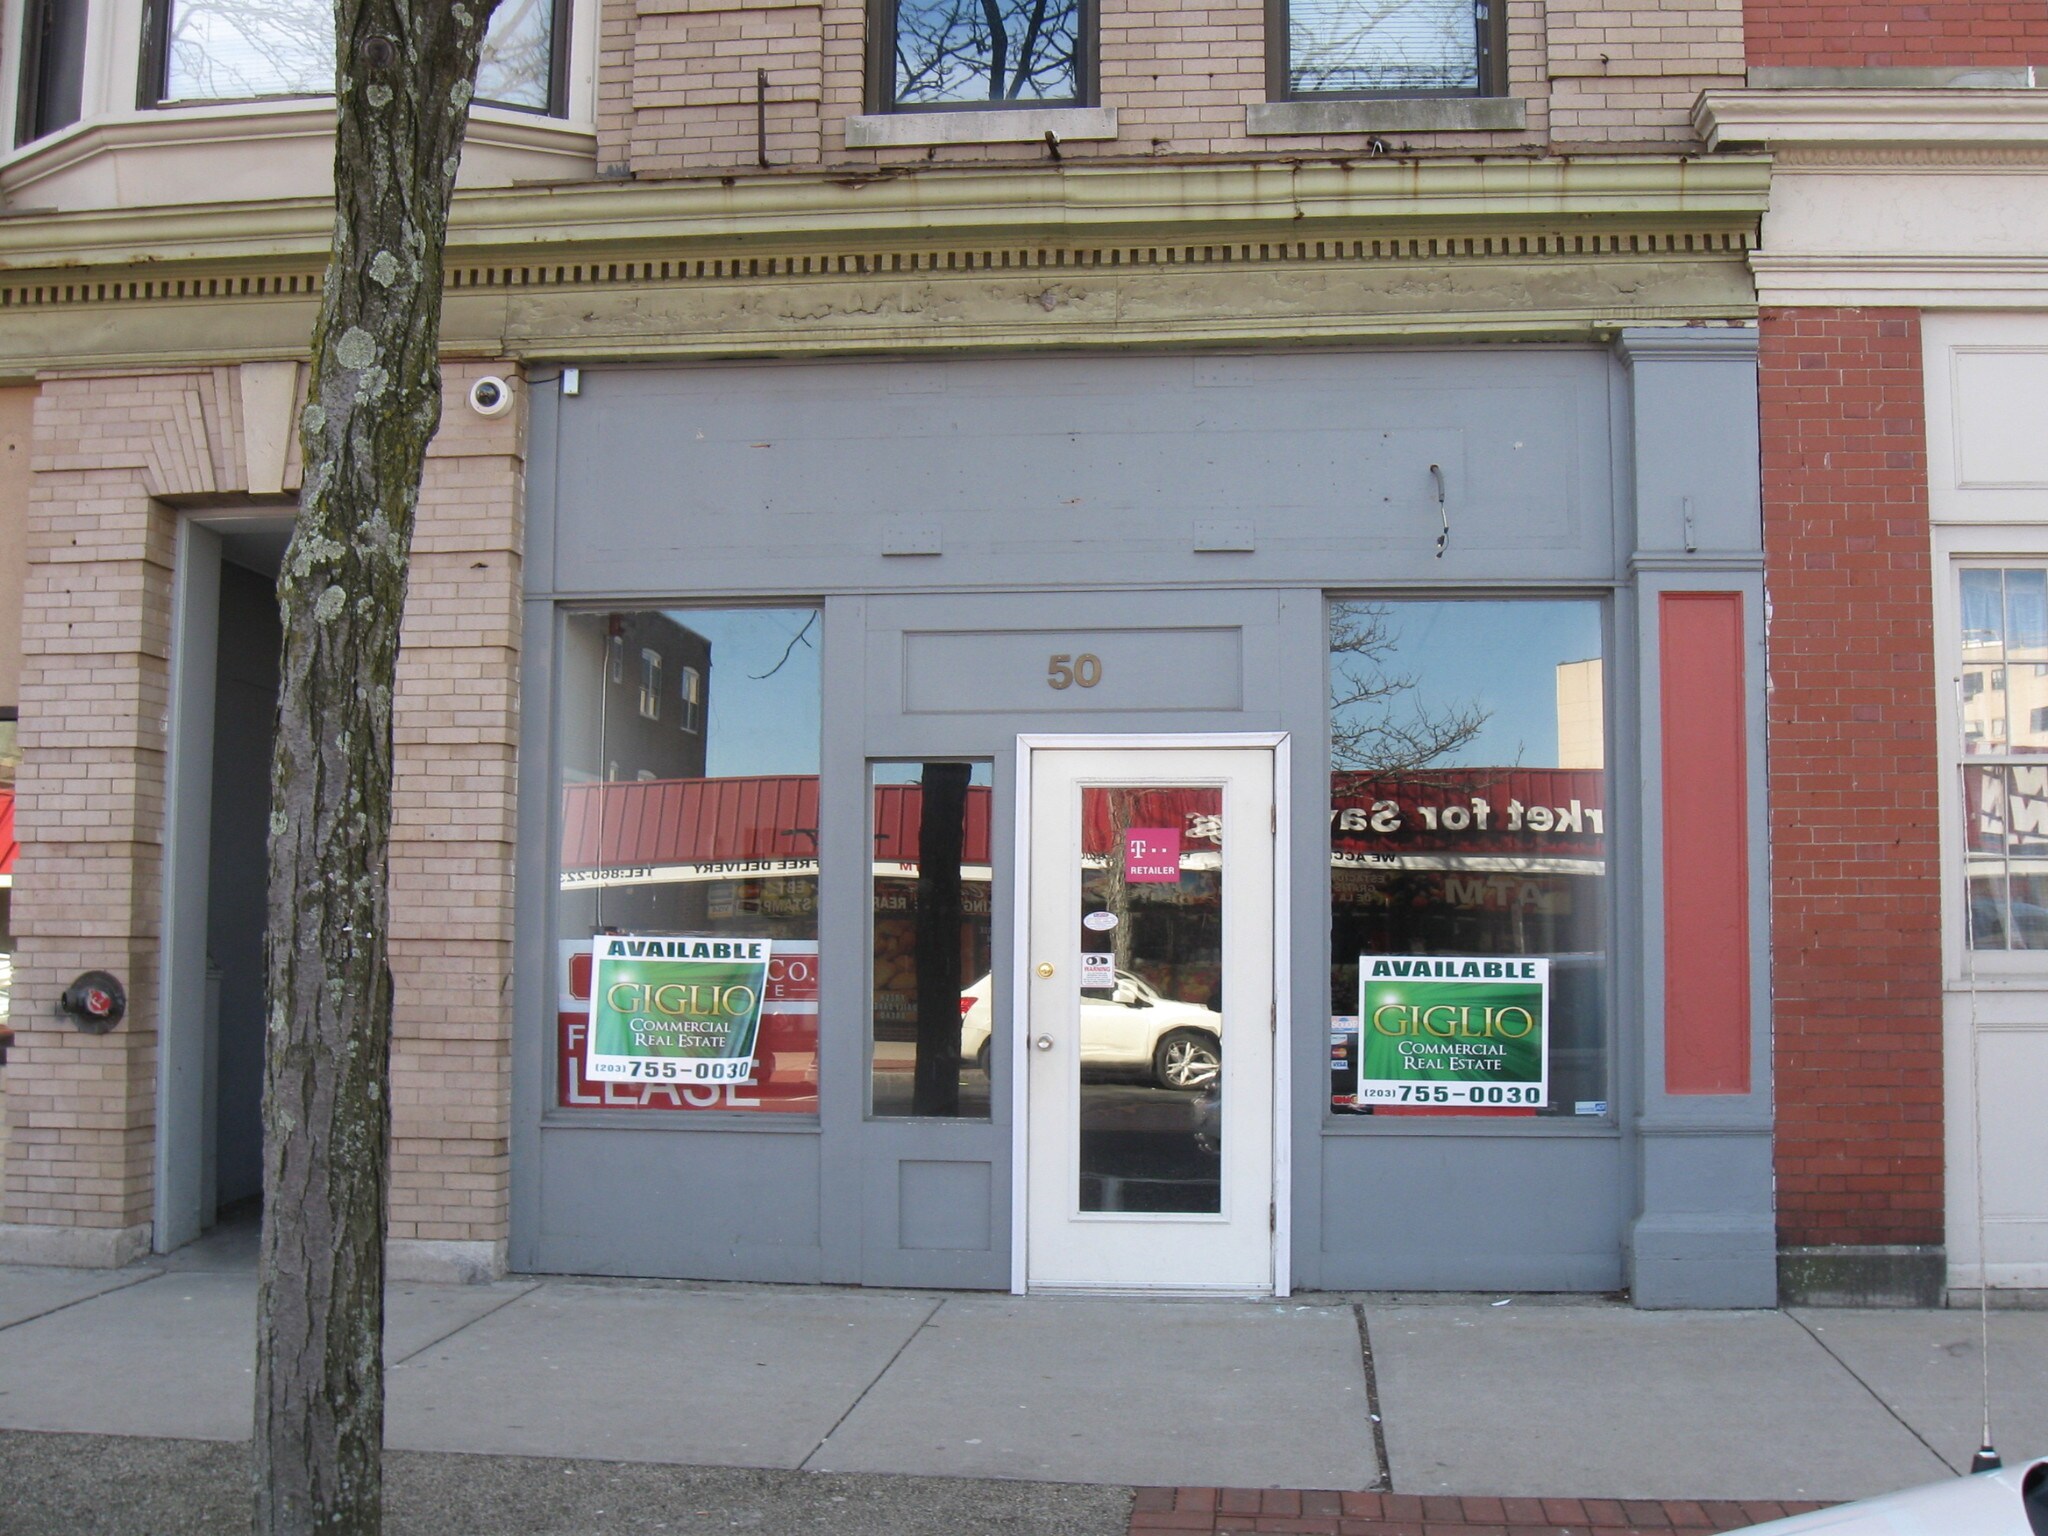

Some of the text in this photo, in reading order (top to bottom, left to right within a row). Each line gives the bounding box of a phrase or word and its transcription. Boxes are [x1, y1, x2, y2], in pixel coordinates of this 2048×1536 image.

[1047, 653, 1102, 690] 50
[1131, 866, 1175, 875] RETAILER
[607, 940, 762, 959] AVAILABLE
[1372, 960, 1536, 978] AVAILABLE
[606, 982, 757, 1017] GIGLIO
[630, 1018, 731, 1033] COMMERCIAL
[1372, 1003, 1535, 1039] GIGLIO
[635, 1033, 726, 1048] REAL ESTATE
[1398, 1041, 1507, 1056] COMMERCIAL
[595, 1061, 749, 1079] (203) 755-0030
[1404, 1057, 1501, 1072] REAL ESTATE
[1364, 1086, 1540, 1104] (203) 755-0030
